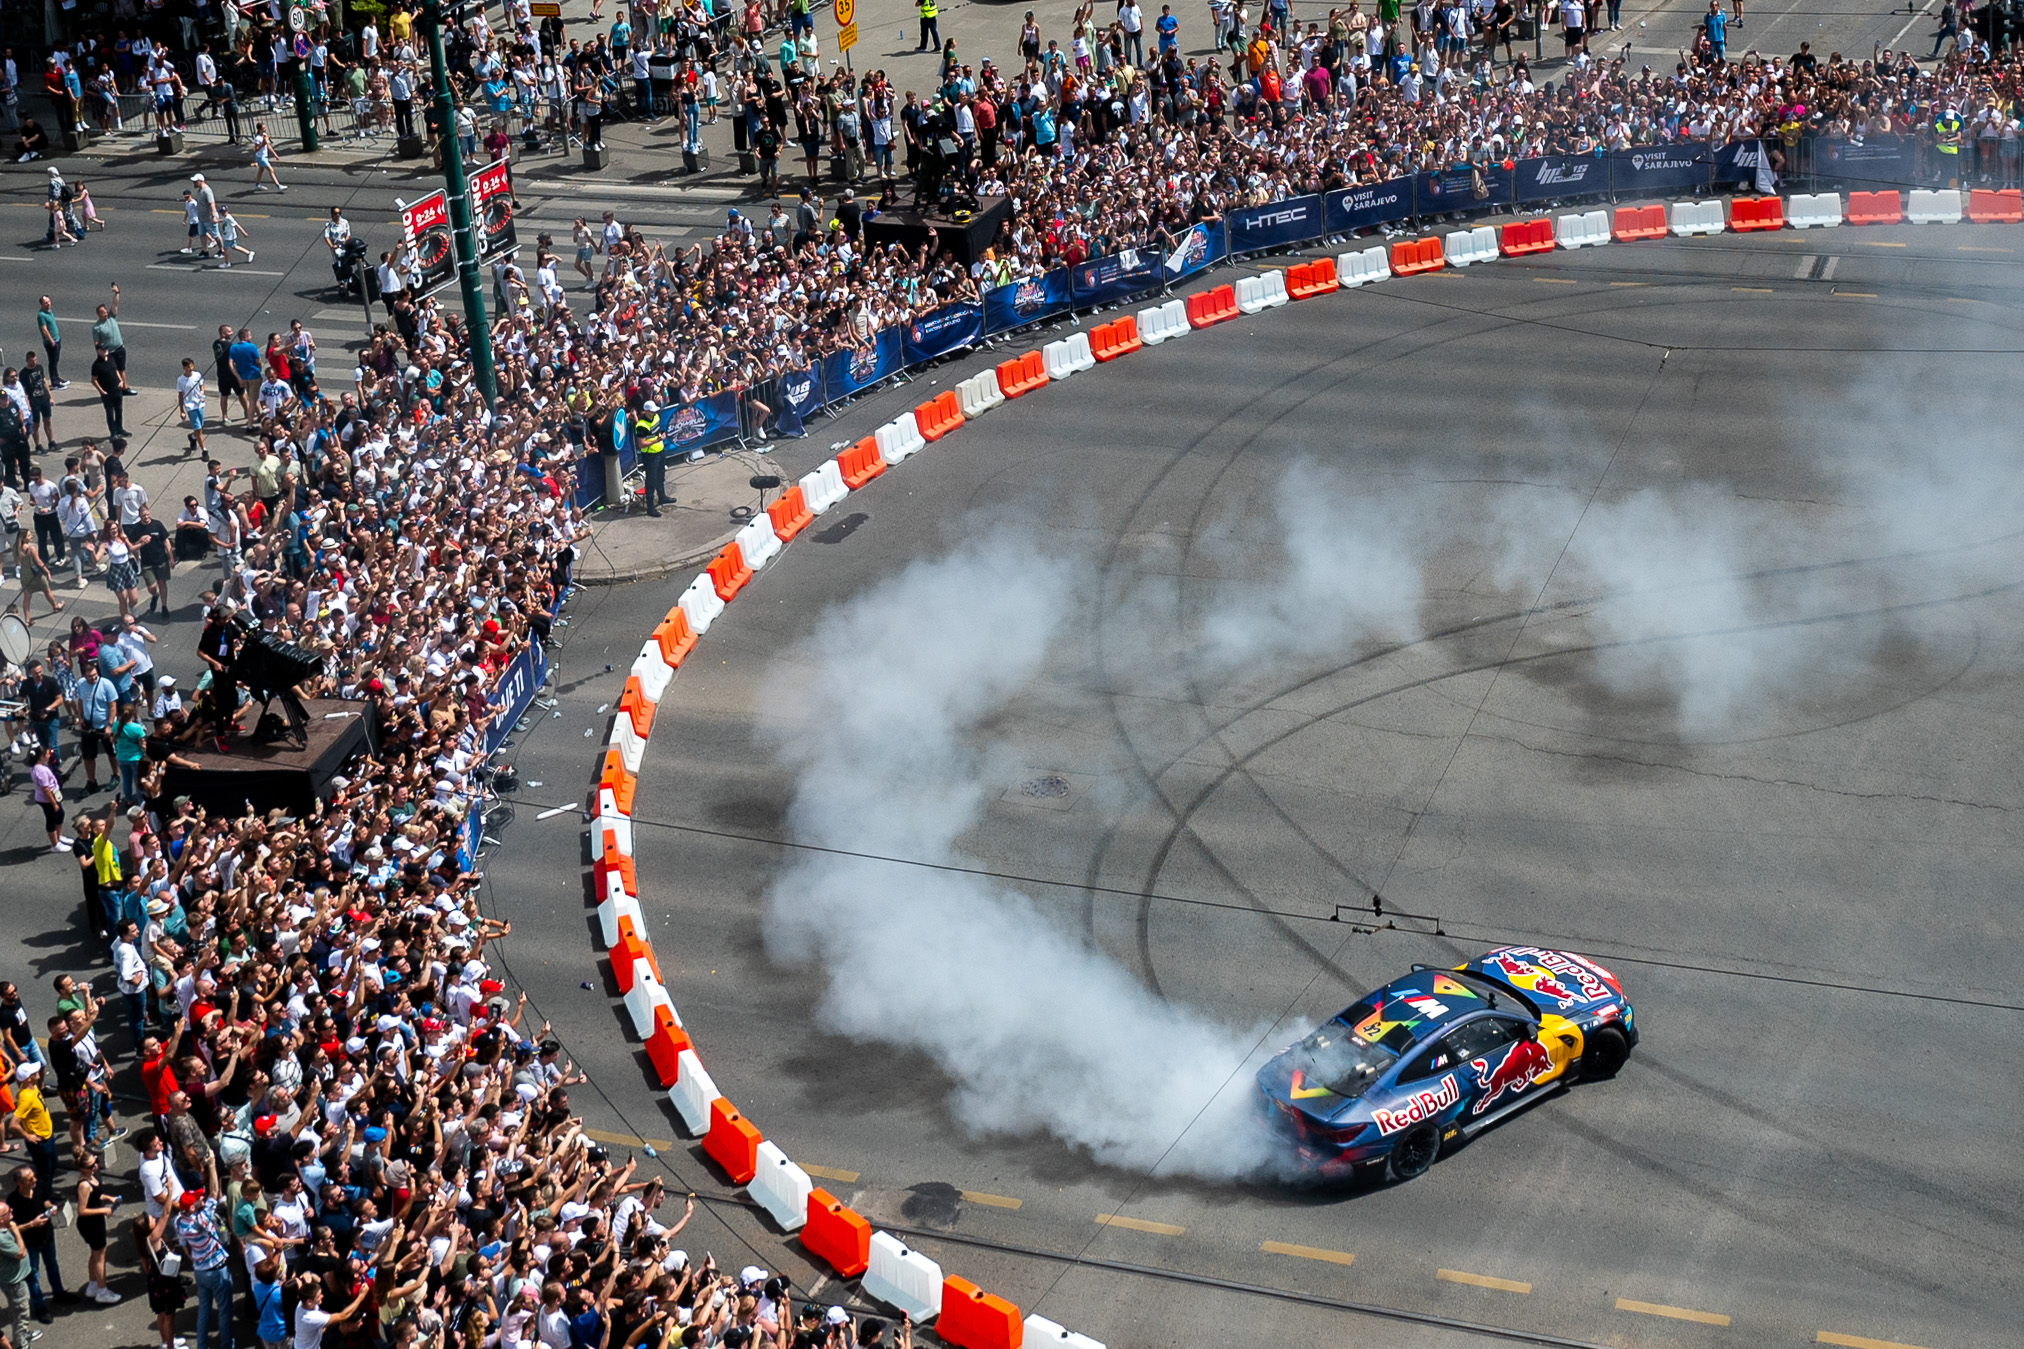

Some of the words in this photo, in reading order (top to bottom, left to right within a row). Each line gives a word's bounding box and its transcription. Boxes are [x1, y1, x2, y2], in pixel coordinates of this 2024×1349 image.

[292, 11, 303, 26] 60
[1644, 152, 1667, 162] VISIT
[1644, 159, 1693, 170] SARAJEVO
[1353, 191, 1374, 202] VISIT
[1354, 195, 1398, 211] SARAJEVO
[471, 178, 488, 254] CASINO
[1245, 207, 1307, 231] HTEC
[402, 211, 423, 289] CASINO
[514, 667, 525, 698] TI
[1551, 964, 1613, 1002] Red
[1371, 1095, 1427, 1136] Red
[1417, 1073, 1460, 1118] Bull
